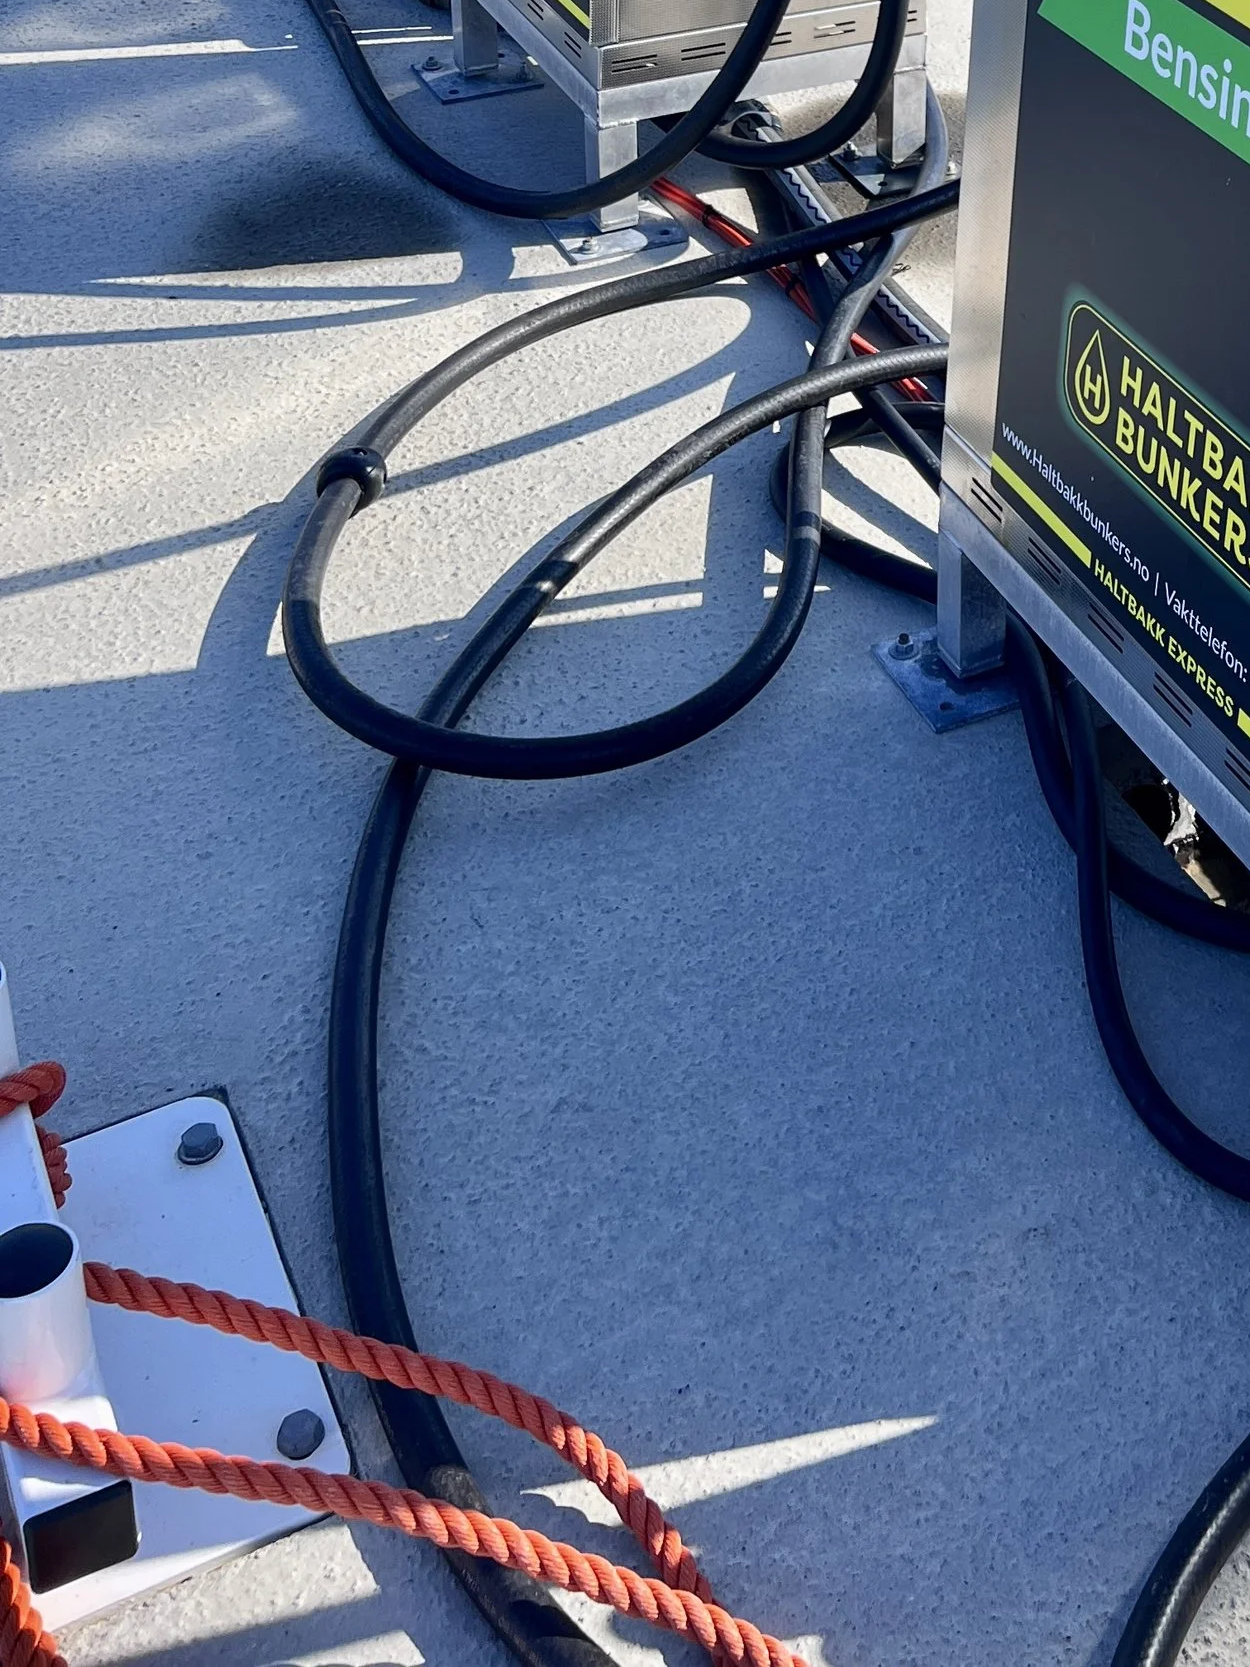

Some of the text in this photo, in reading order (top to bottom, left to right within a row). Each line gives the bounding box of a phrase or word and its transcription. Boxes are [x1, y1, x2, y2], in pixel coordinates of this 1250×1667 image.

[1001, 421, 1150, 583] www.Haltbakkbunkers.no
[1164, 581, 1248, 683] Vakttelefon:
[1093, 558, 1235, 718] HALTBAKK EXPRESS
